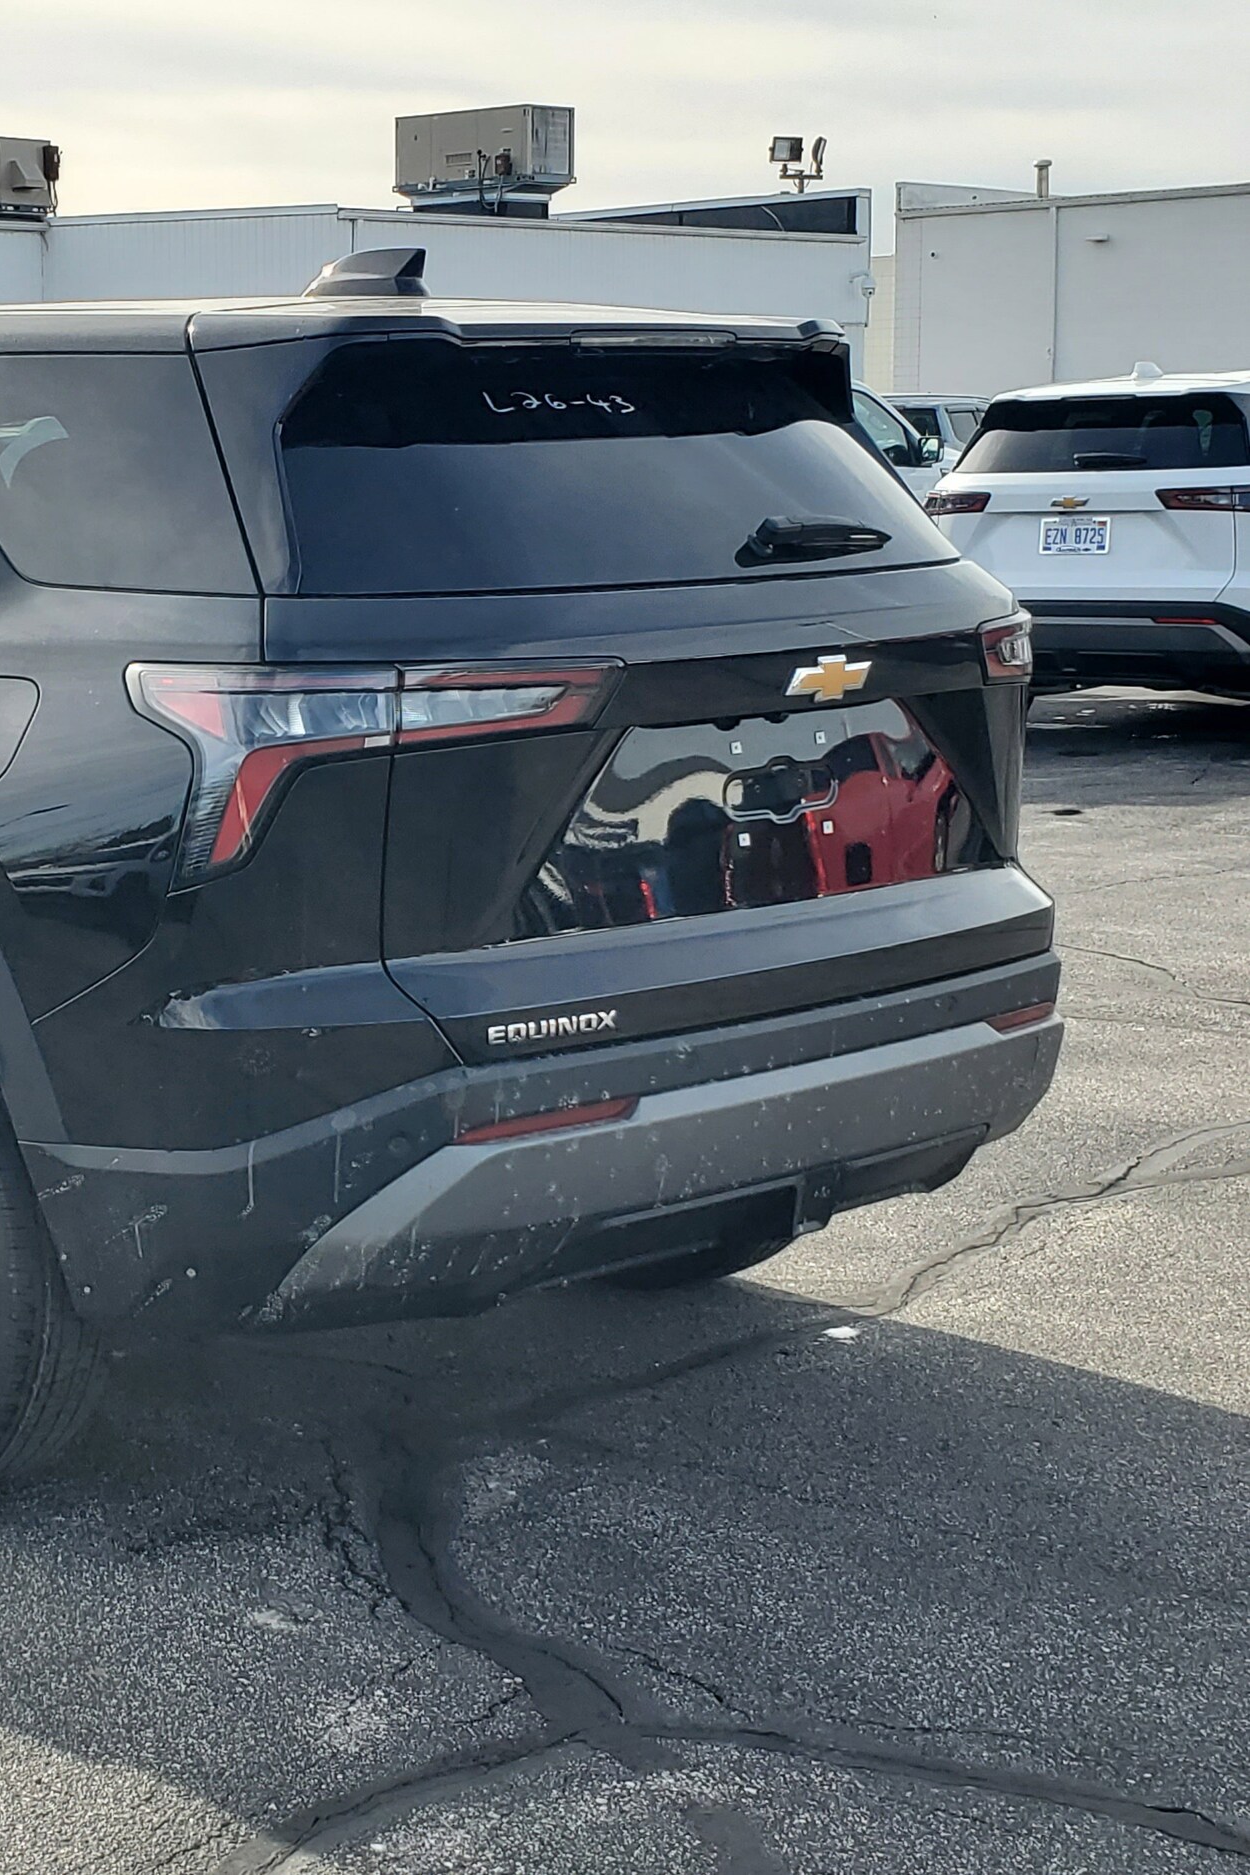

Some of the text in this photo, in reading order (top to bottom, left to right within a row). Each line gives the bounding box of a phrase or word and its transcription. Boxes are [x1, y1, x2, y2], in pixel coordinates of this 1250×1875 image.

[482, 391, 636, 413] L26-43
[1044, 527, 1105, 545] EZN 8725
[487, 1009, 618, 1046] EQUINOX
